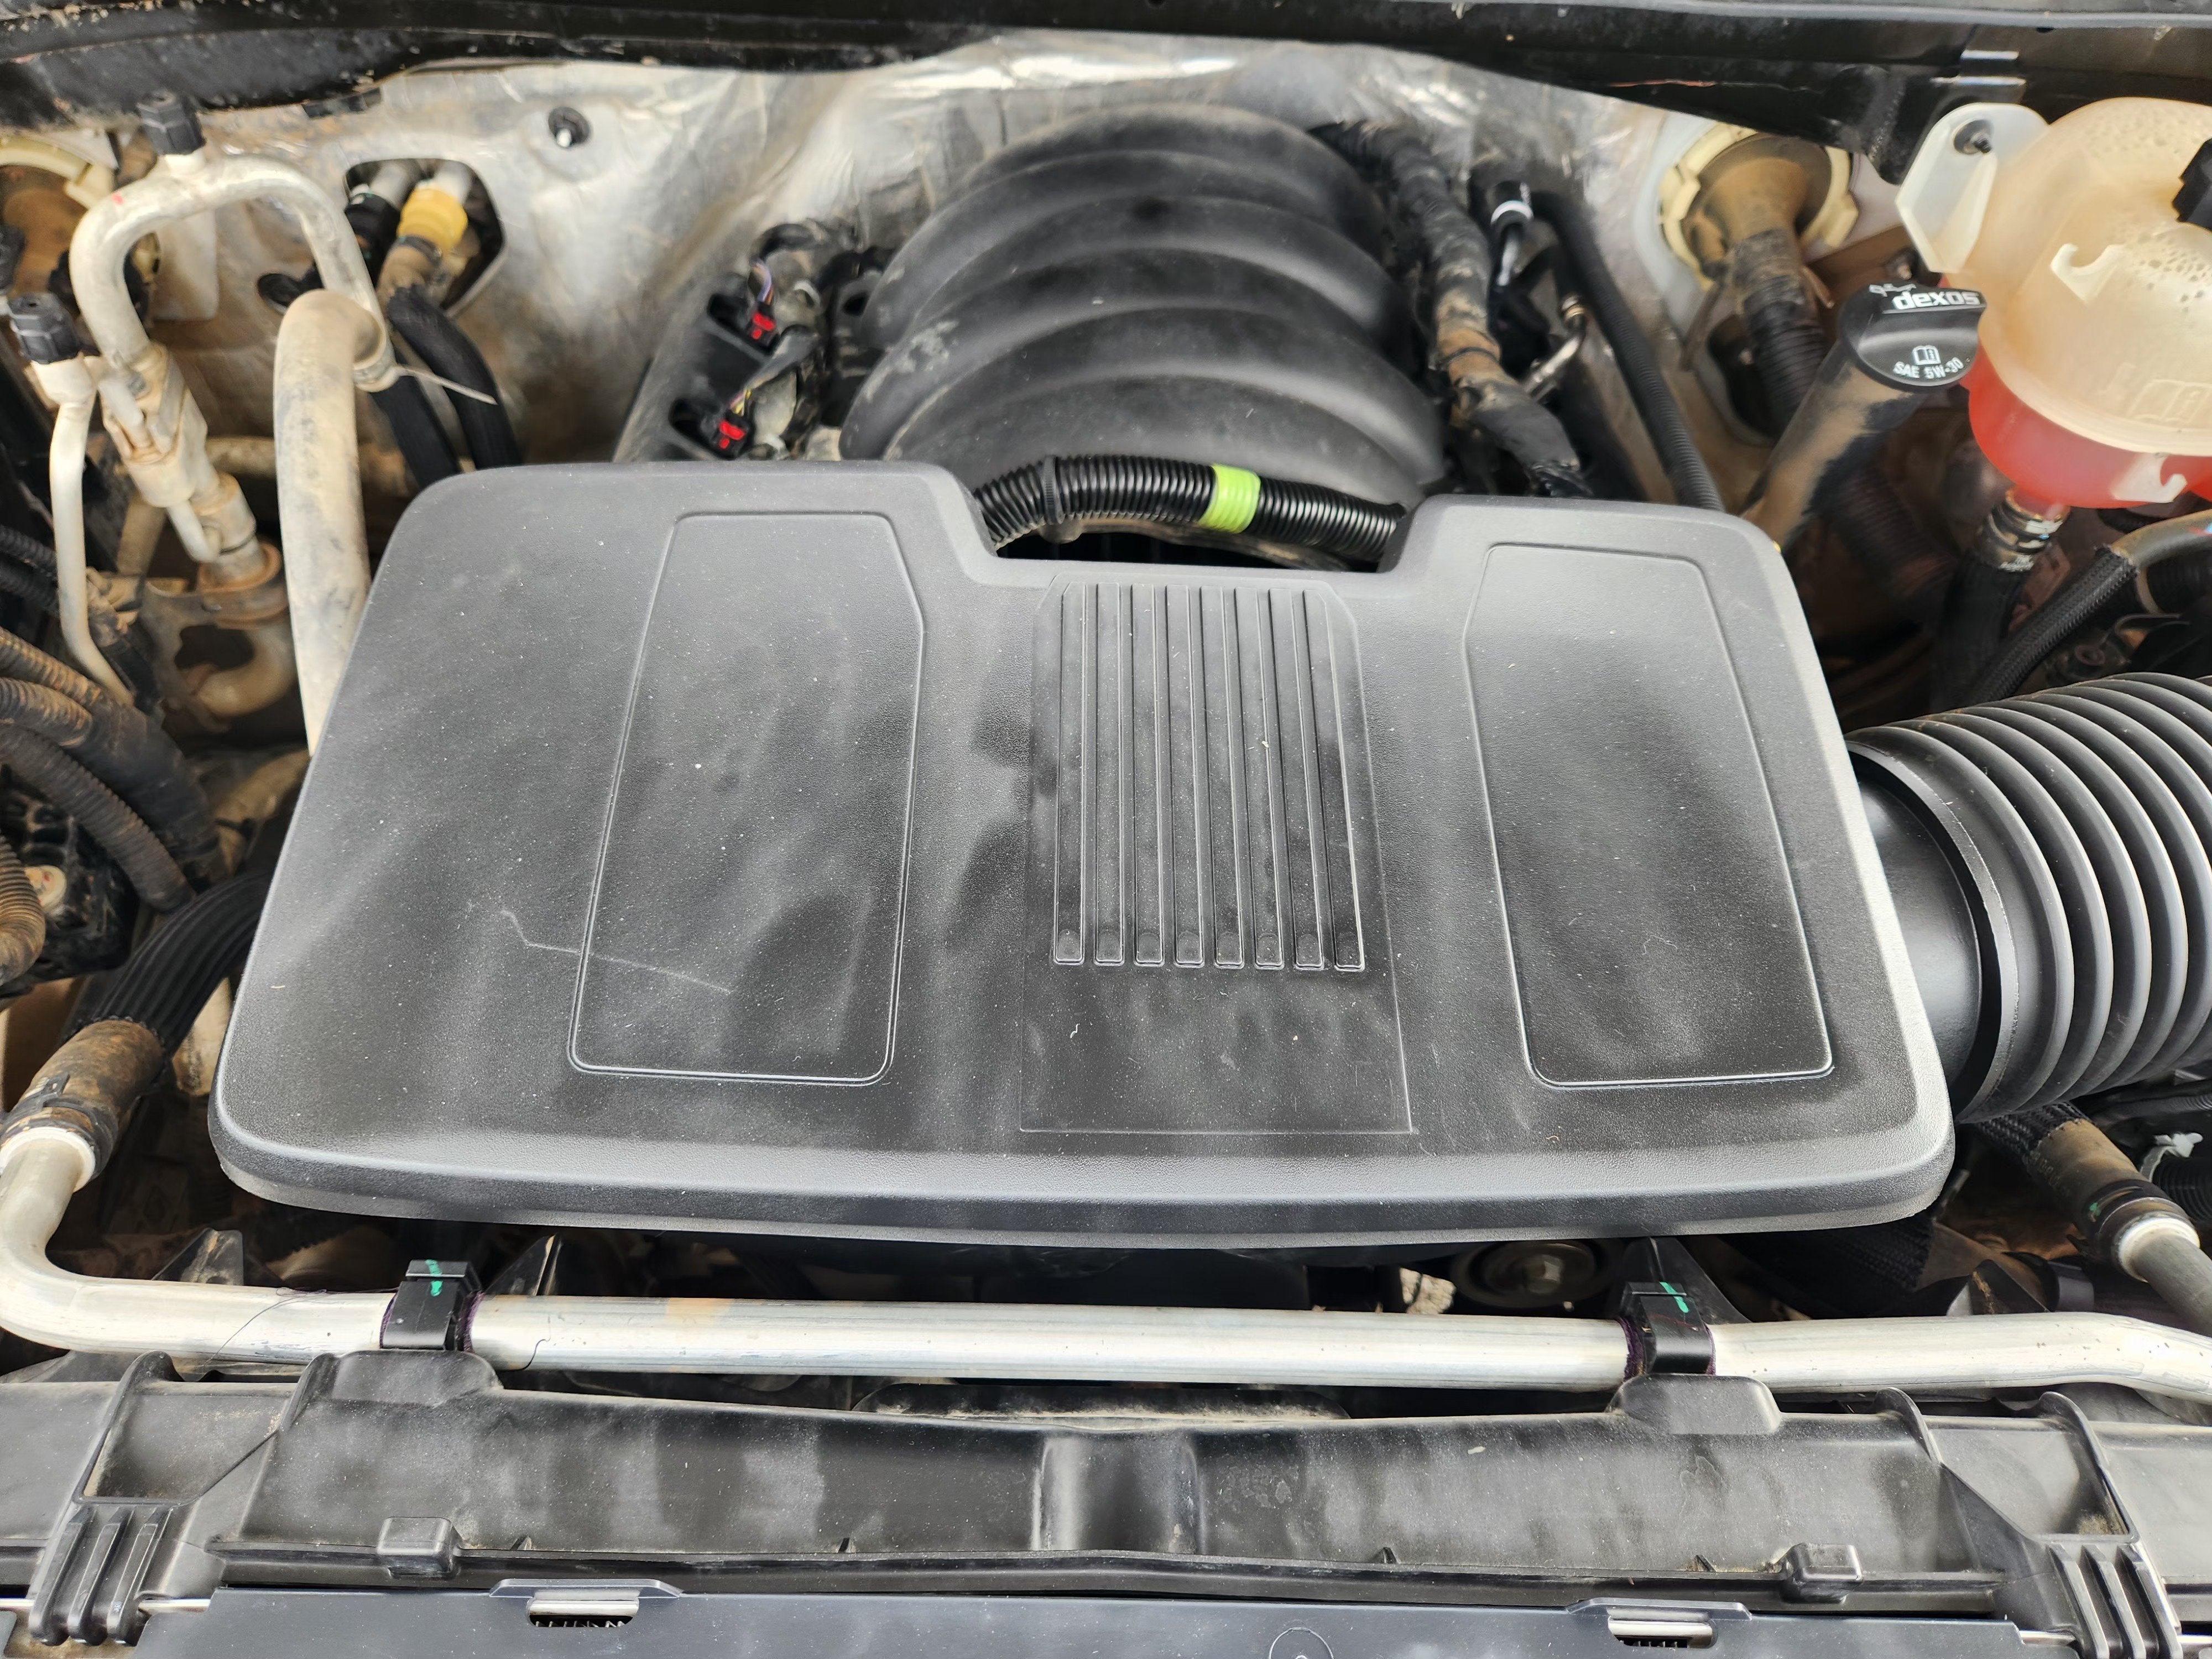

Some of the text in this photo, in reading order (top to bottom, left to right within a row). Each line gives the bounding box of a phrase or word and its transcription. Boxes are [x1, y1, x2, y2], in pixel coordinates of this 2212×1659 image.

[1892, 291, 1980, 310] dexos
[1893, 357, 1964, 379] SAE 5W-30
